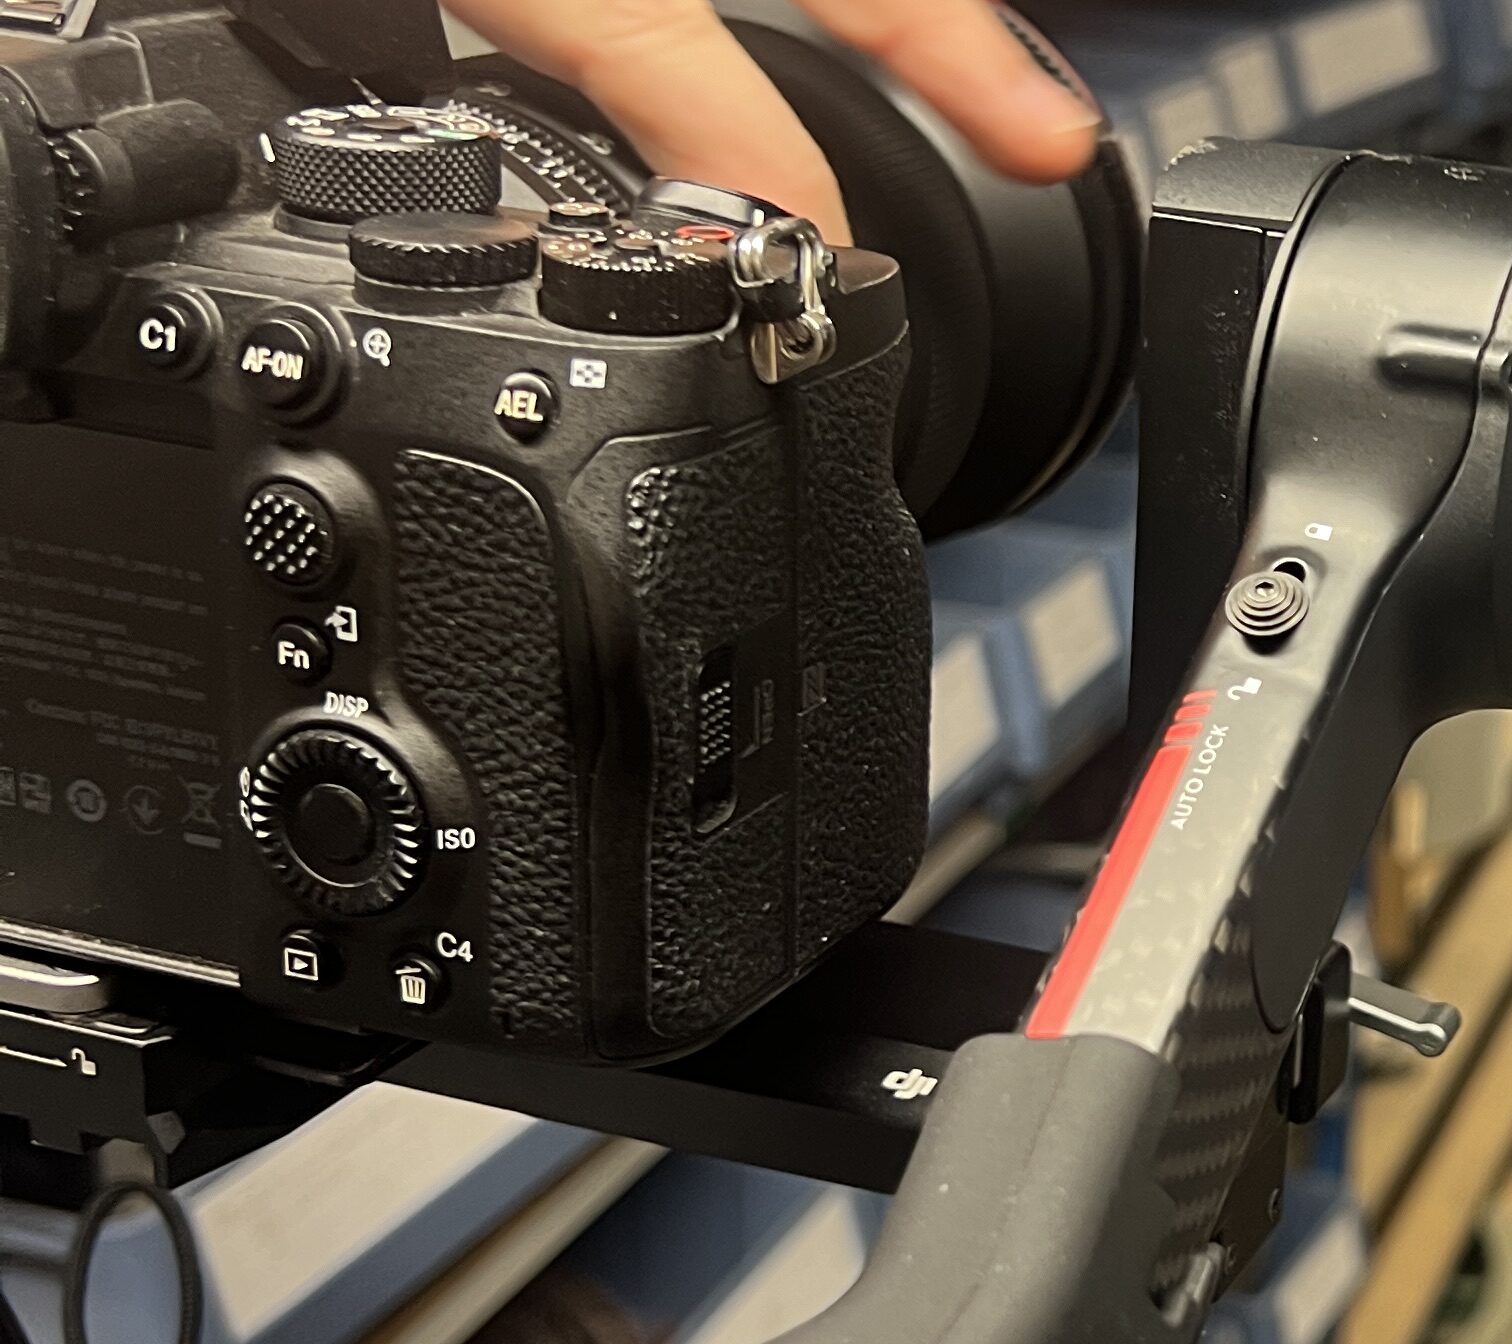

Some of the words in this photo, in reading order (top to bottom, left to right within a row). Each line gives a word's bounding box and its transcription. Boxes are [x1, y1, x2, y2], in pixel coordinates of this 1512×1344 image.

[139, 318, 176, 352] C1
[241, 345, 304, 380] AF-ON
[494, 389, 544, 422] AEL
[278, 640, 310, 669] Fn
[323, 690, 369, 718] DISP
[1170, 777, 1203, 830] AUTO
[1192, 724, 1229, 774] LOCK
[437, 827, 476, 850] ISO
[437, 932, 473, 962] C4
